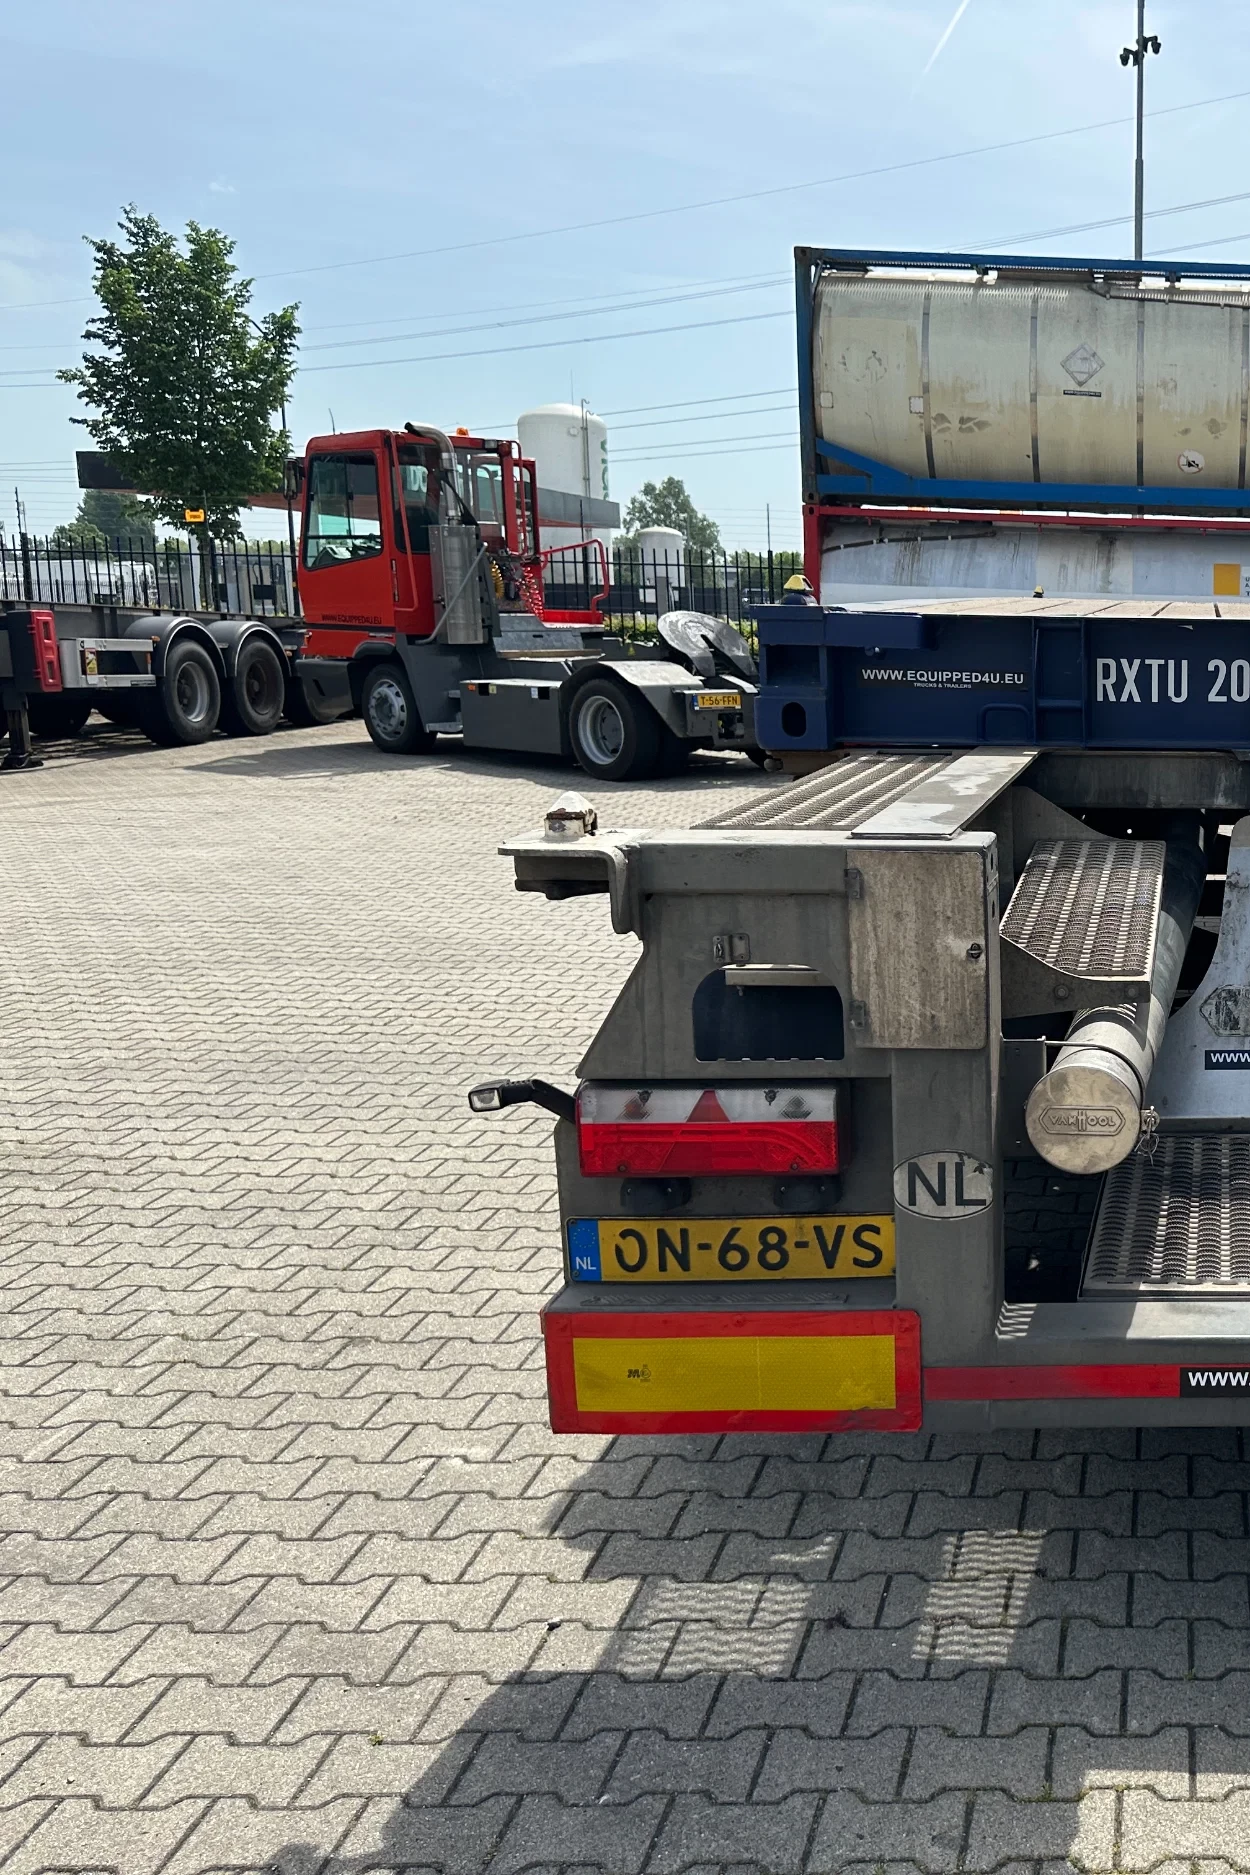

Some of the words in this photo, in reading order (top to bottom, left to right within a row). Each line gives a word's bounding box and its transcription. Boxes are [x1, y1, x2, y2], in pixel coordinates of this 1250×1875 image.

[861, 668, 1025, 684] WWW.EQUIPPED4U.EU
[1096, 657, 1189, 703] RXTU
[1207, 658, 1250, 703] 20
[701, 695, 738, 706] T-56-FFN
[907, 1161, 988, 1207] NL
[575, 1256, 597, 1271] NL
[614, 1223, 884, 1274] ON-68-VS
